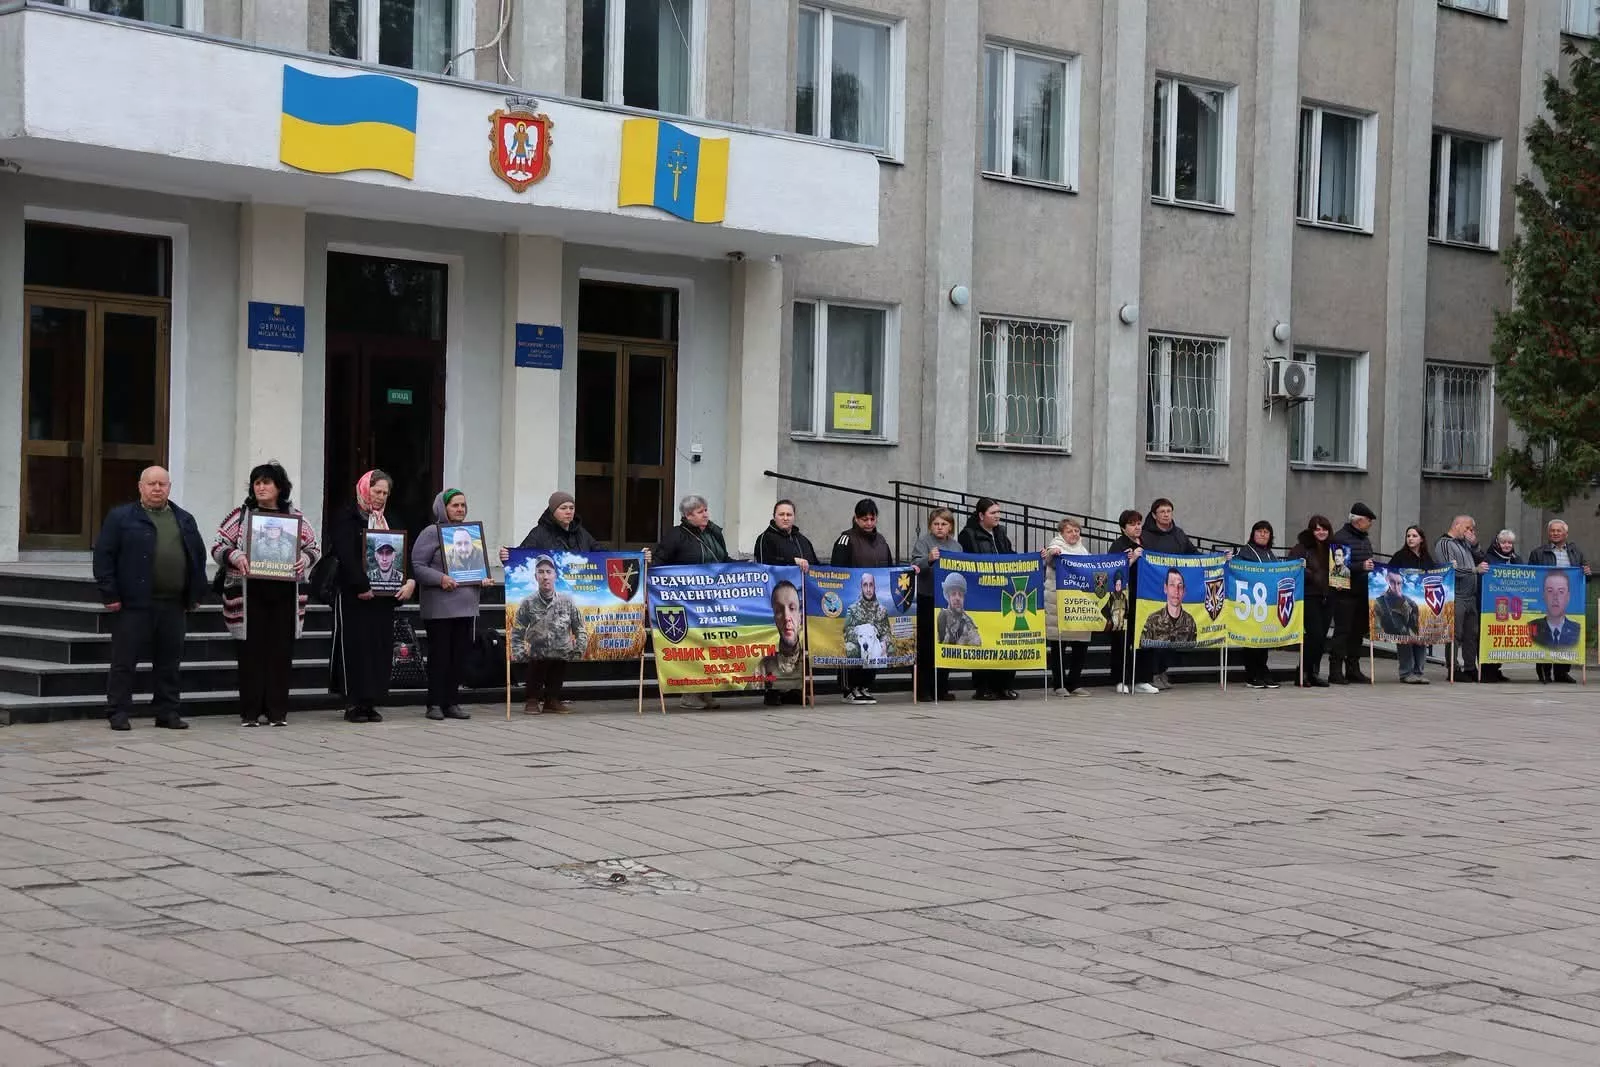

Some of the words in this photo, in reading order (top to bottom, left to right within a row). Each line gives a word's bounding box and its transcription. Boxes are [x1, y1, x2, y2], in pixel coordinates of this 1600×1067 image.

[391, 392, 409, 401] ВХІД
[651, 575, 714, 587] РЕДЧИЦЬ
[717, 572, 769, 586] ДМИТРО
[1493, 569, 1536, 579] ЗУБРЕЙЧУК
[660, 587, 764, 601] ВАЛЕНТИНОВИЧ
[1235, 580, 1268, 623] 58
[698, 616, 737, 625] 27.12.1983
[703, 632, 717, 640] 115
[719, 631, 738, 639] ТРО
[1488, 625, 1506, 635] ЗНИК
[662, 648, 705, 661] ЗНИК
[708, 644, 776, 660] БЕЗВІСТИ
[942, 648, 961, 659] ЗНИК
[963, 649, 998, 660] БЕЗВІСТИ
[1000, 649, 1035, 660] 24.06.2025
